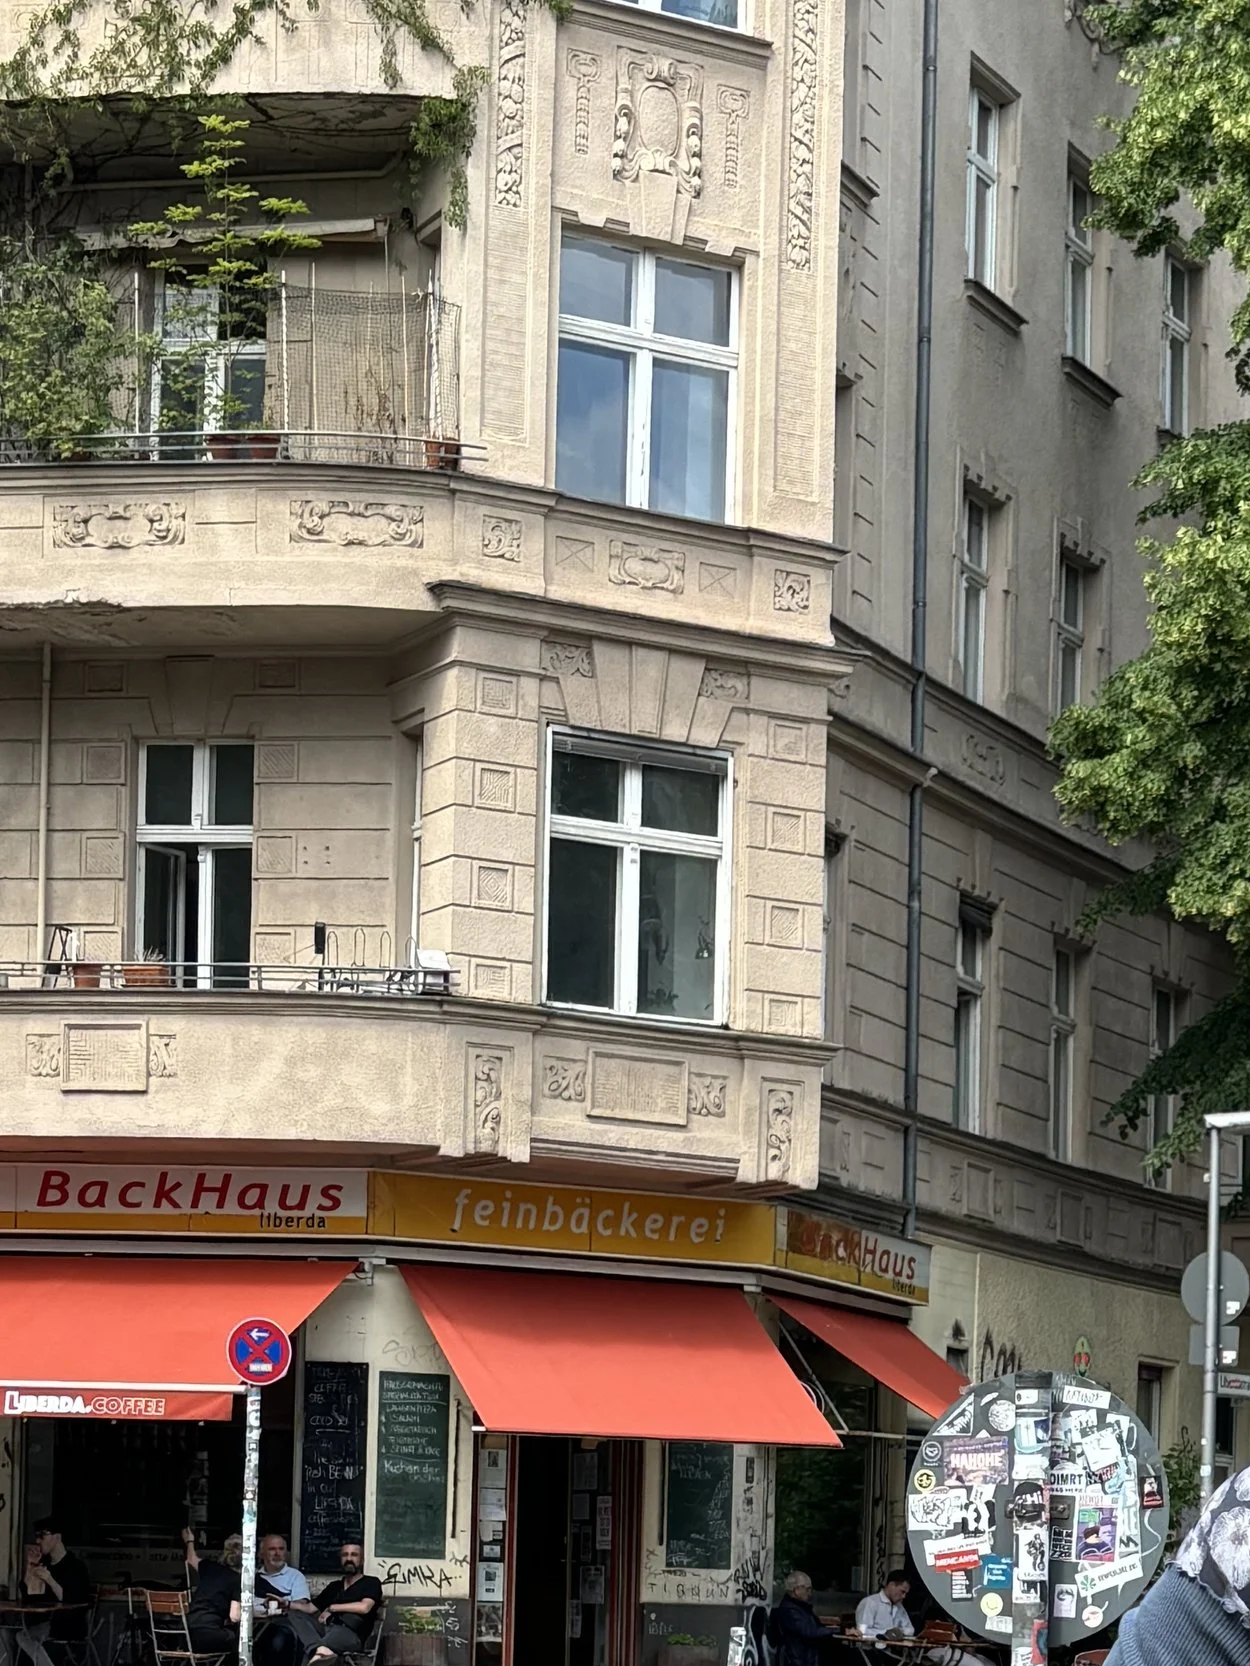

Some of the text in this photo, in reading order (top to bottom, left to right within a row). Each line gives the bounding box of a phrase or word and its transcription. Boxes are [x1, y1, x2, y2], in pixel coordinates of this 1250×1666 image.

[36, 1170, 345, 1213] BackHaus
[259, 1212, 327, 1230] liberda
[451, 1187, 725, 1245] feinbäckerei
